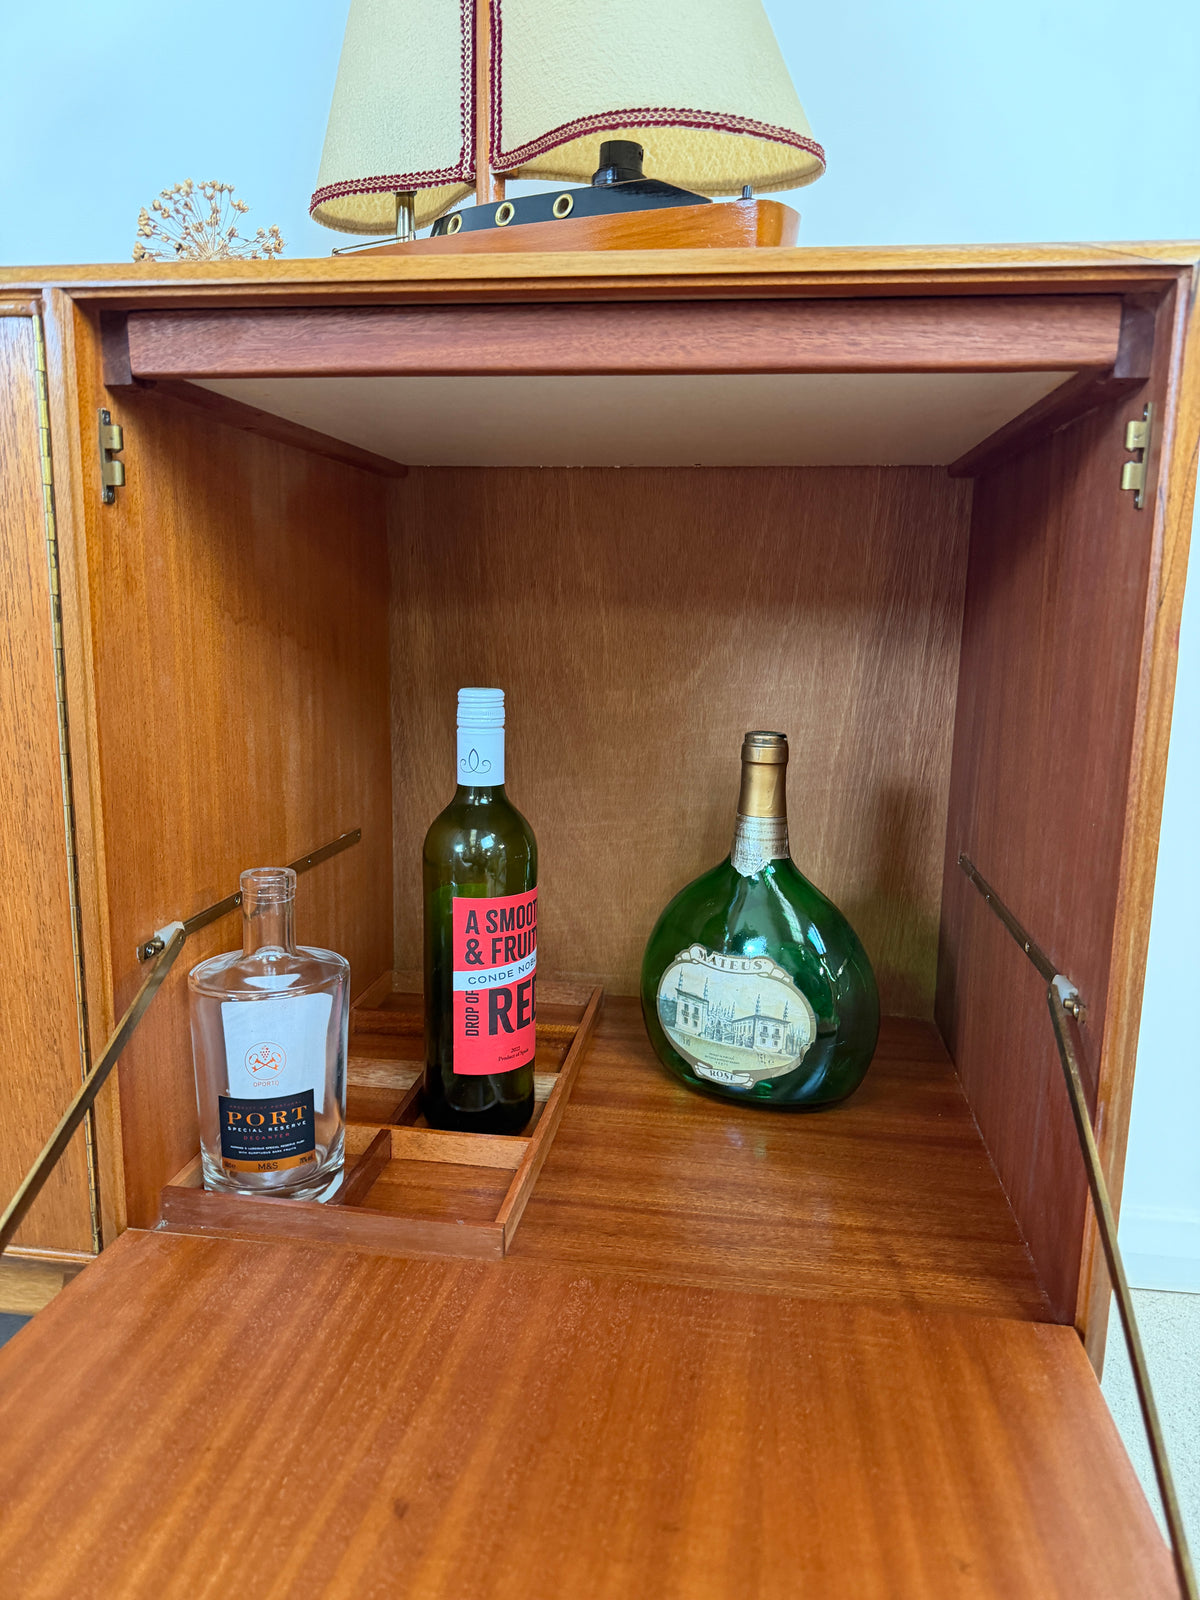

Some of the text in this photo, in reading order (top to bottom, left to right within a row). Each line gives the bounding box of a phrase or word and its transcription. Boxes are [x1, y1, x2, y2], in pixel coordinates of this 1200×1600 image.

[465, 898, 537, 935] A SMOOT
[464, 926, 537, 965] & FRUIT
[467, 969, 514, 985] CONDE
[465, 1007, 480, 1037] DROP
[253, 1080, 280, 1088] OPORTO
[226, 1105, 307, 1127] PORT
[268, 1120, 307, 1132] RESERVE
[243, 1132, 290, 1141] DECANTER
[257, 1162, 279, 1170] M&S
